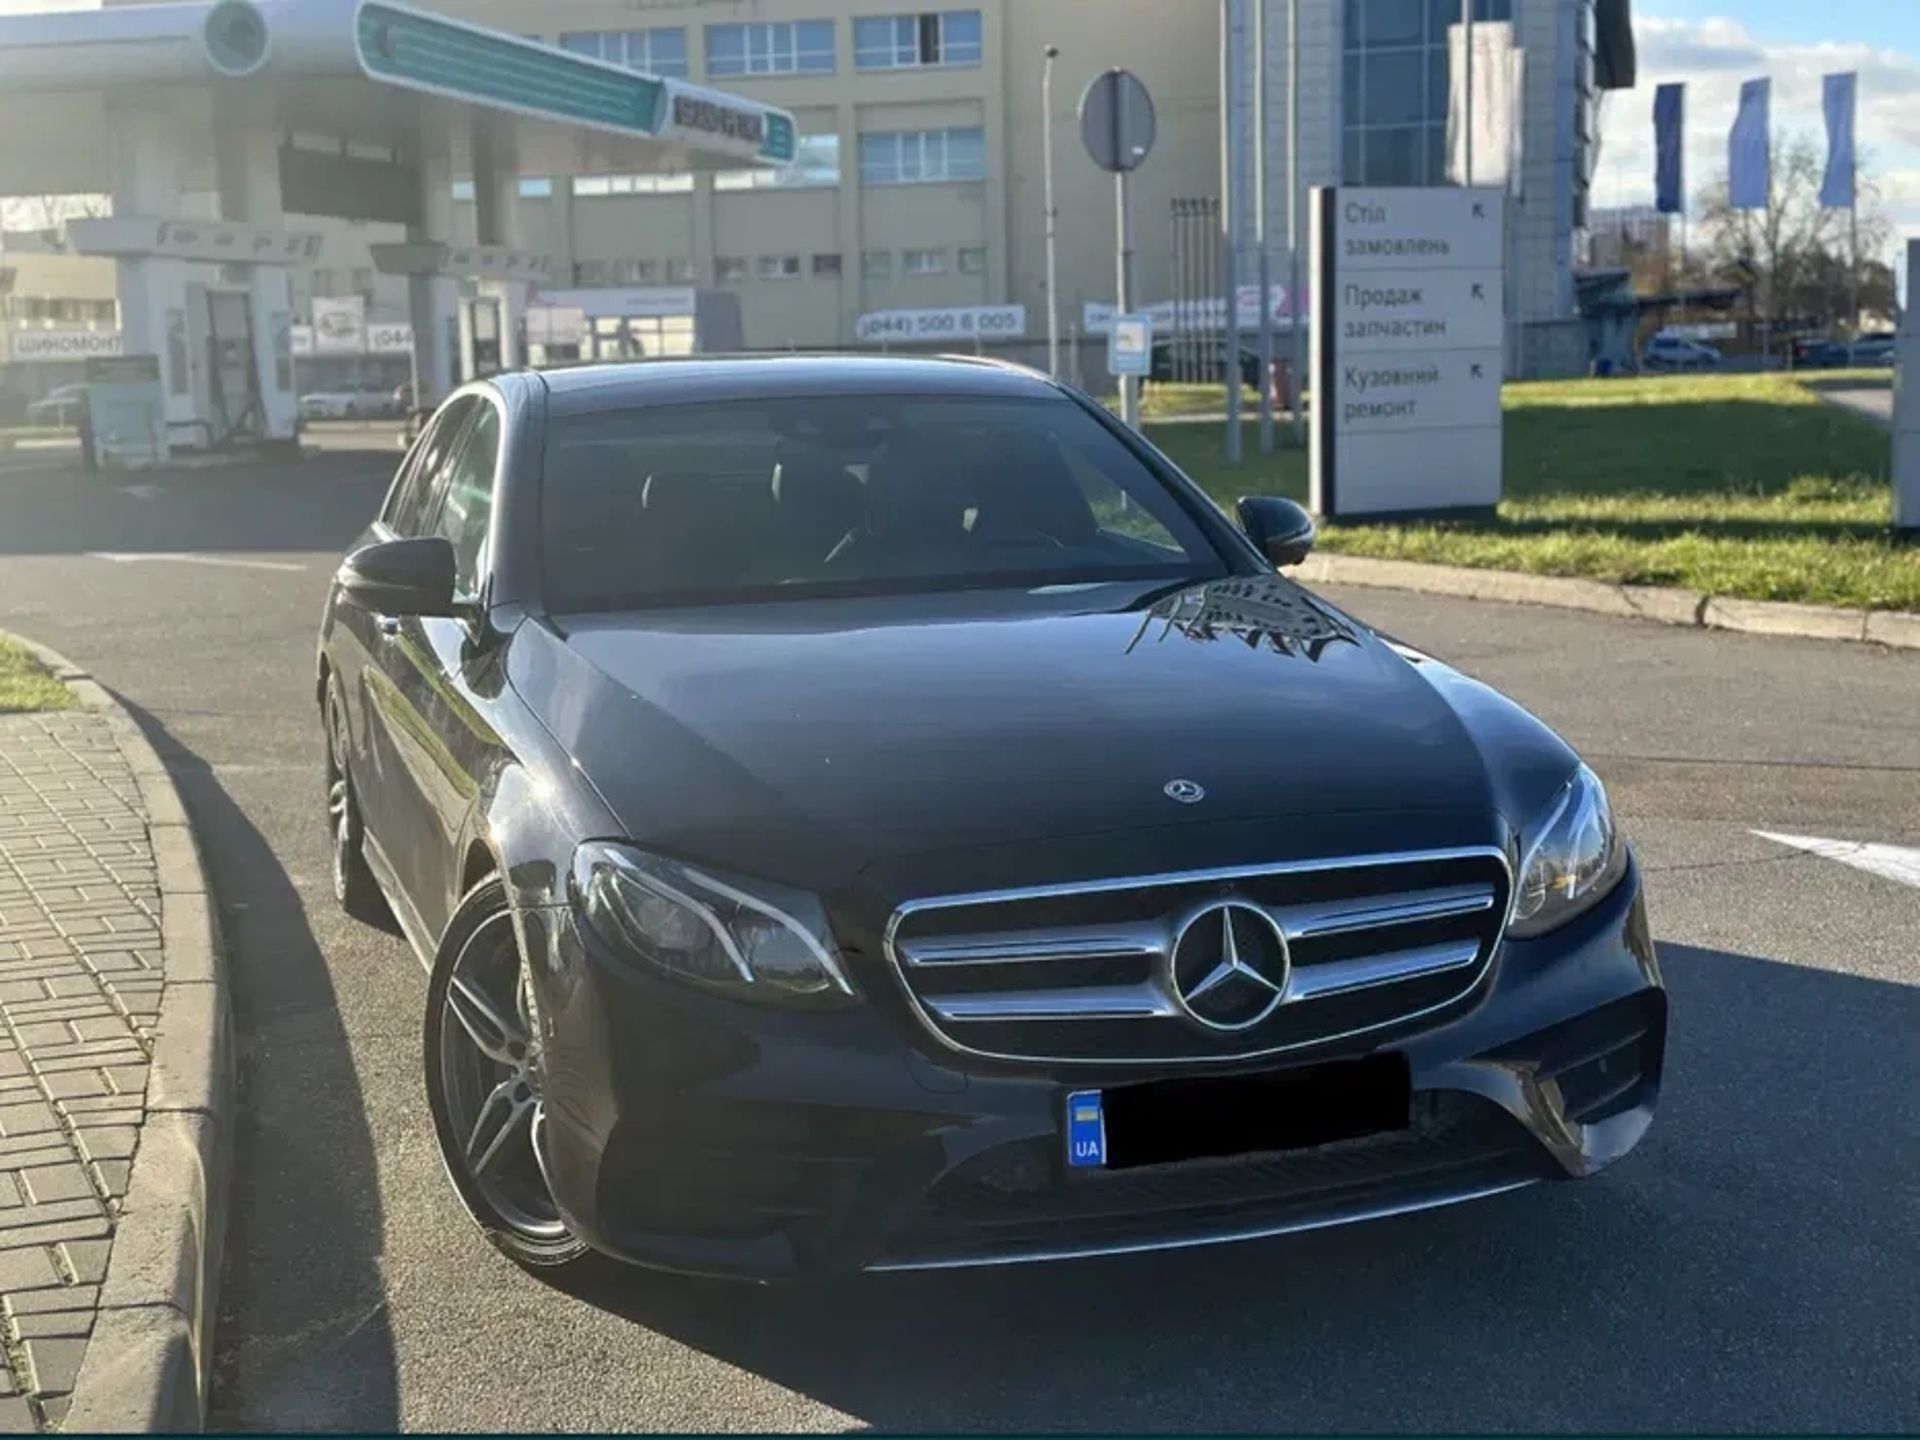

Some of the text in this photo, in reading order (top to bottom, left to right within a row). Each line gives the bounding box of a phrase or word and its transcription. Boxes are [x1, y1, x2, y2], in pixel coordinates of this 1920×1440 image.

[1345, 202, 1386, 223] Стіл
[1345, 238, 1450, 256] замовлень
[1345, 283, 1423, 310] Продаж
[918, 314, 955, 332] 500
[978, 312, 1016, 330] 005
[1344, 319, 1447, 339] запчастин
[1345, 365, 1440, 394] Кузовний
[1344, 401, 1417, 424] ремонт
[1076, 1141, 1099, 1157] UA
